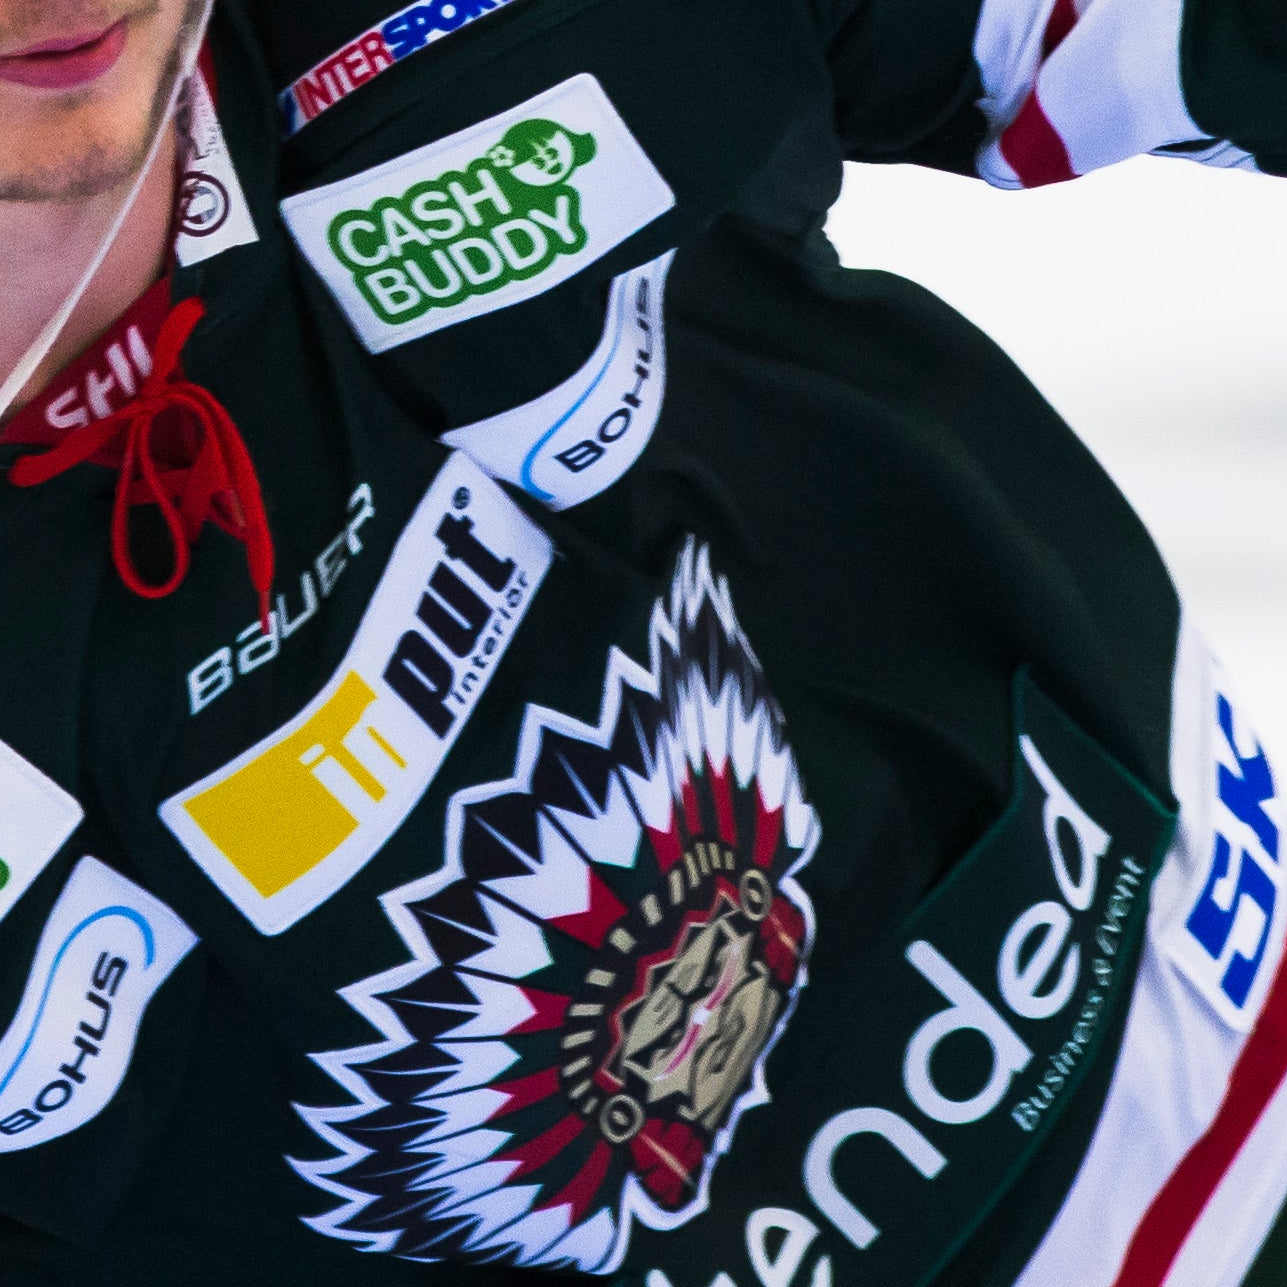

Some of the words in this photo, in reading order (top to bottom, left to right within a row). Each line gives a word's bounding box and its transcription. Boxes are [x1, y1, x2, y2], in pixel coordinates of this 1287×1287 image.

[336, 170, 510, 268] CASH
[365, 195, 579, 316] BUDDY
[555, 278, 649, 472] BOHUS
[187, 483, 374, 715] BAUER
